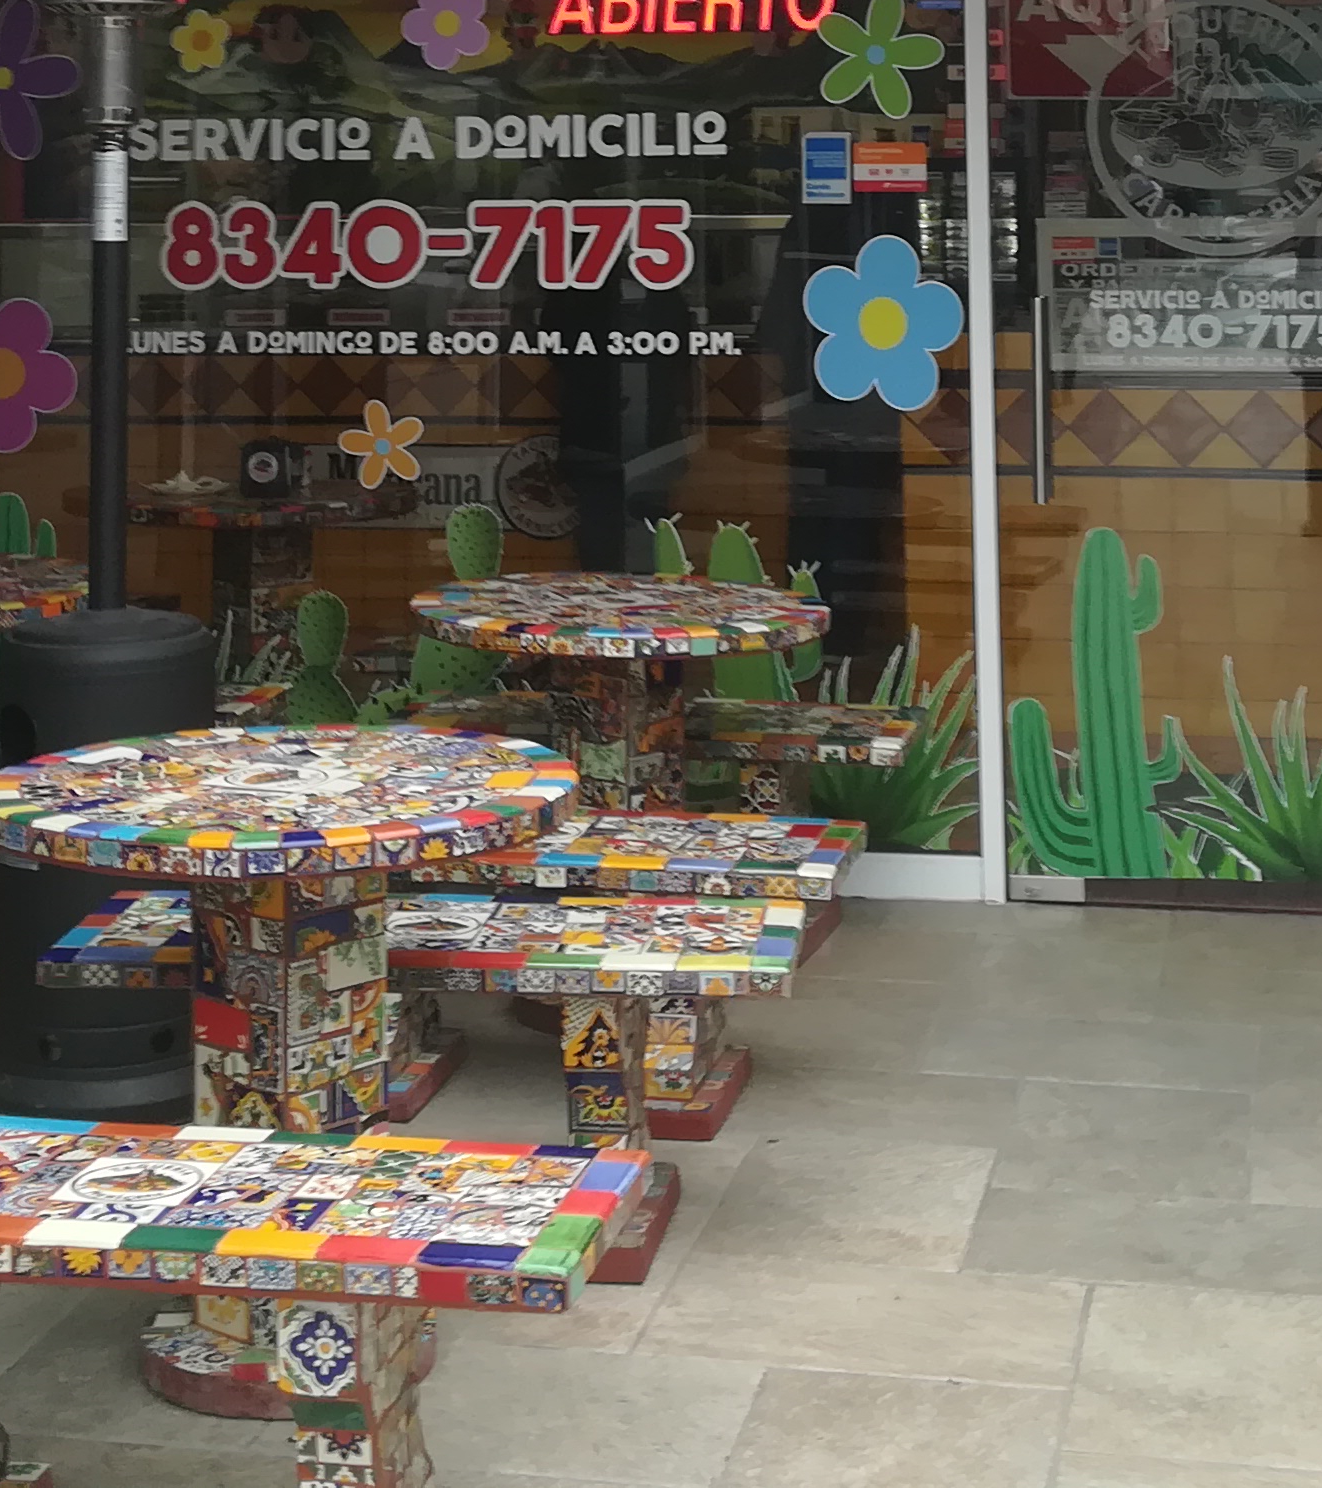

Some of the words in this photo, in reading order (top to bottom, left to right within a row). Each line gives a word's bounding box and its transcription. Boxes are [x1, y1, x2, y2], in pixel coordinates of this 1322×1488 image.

[393, 116, 435, 160] A
[162, 198, 695, 291] 8340-7175
[1210, 290, 1231, 309] A
[127, 331, 206, 354] UNES
[216, 331, 239, 354] A
[379, 331, 418, 355] DE
[427, 330, 499, 355] 8:00
[508, 330, 569, 355] A.M.
[574, 331, 598, 355] A
[607, 330, 680, 355] 3:00
[688, 331, 742, 355] P.M.
[328, 452, 482, 505] Mana
